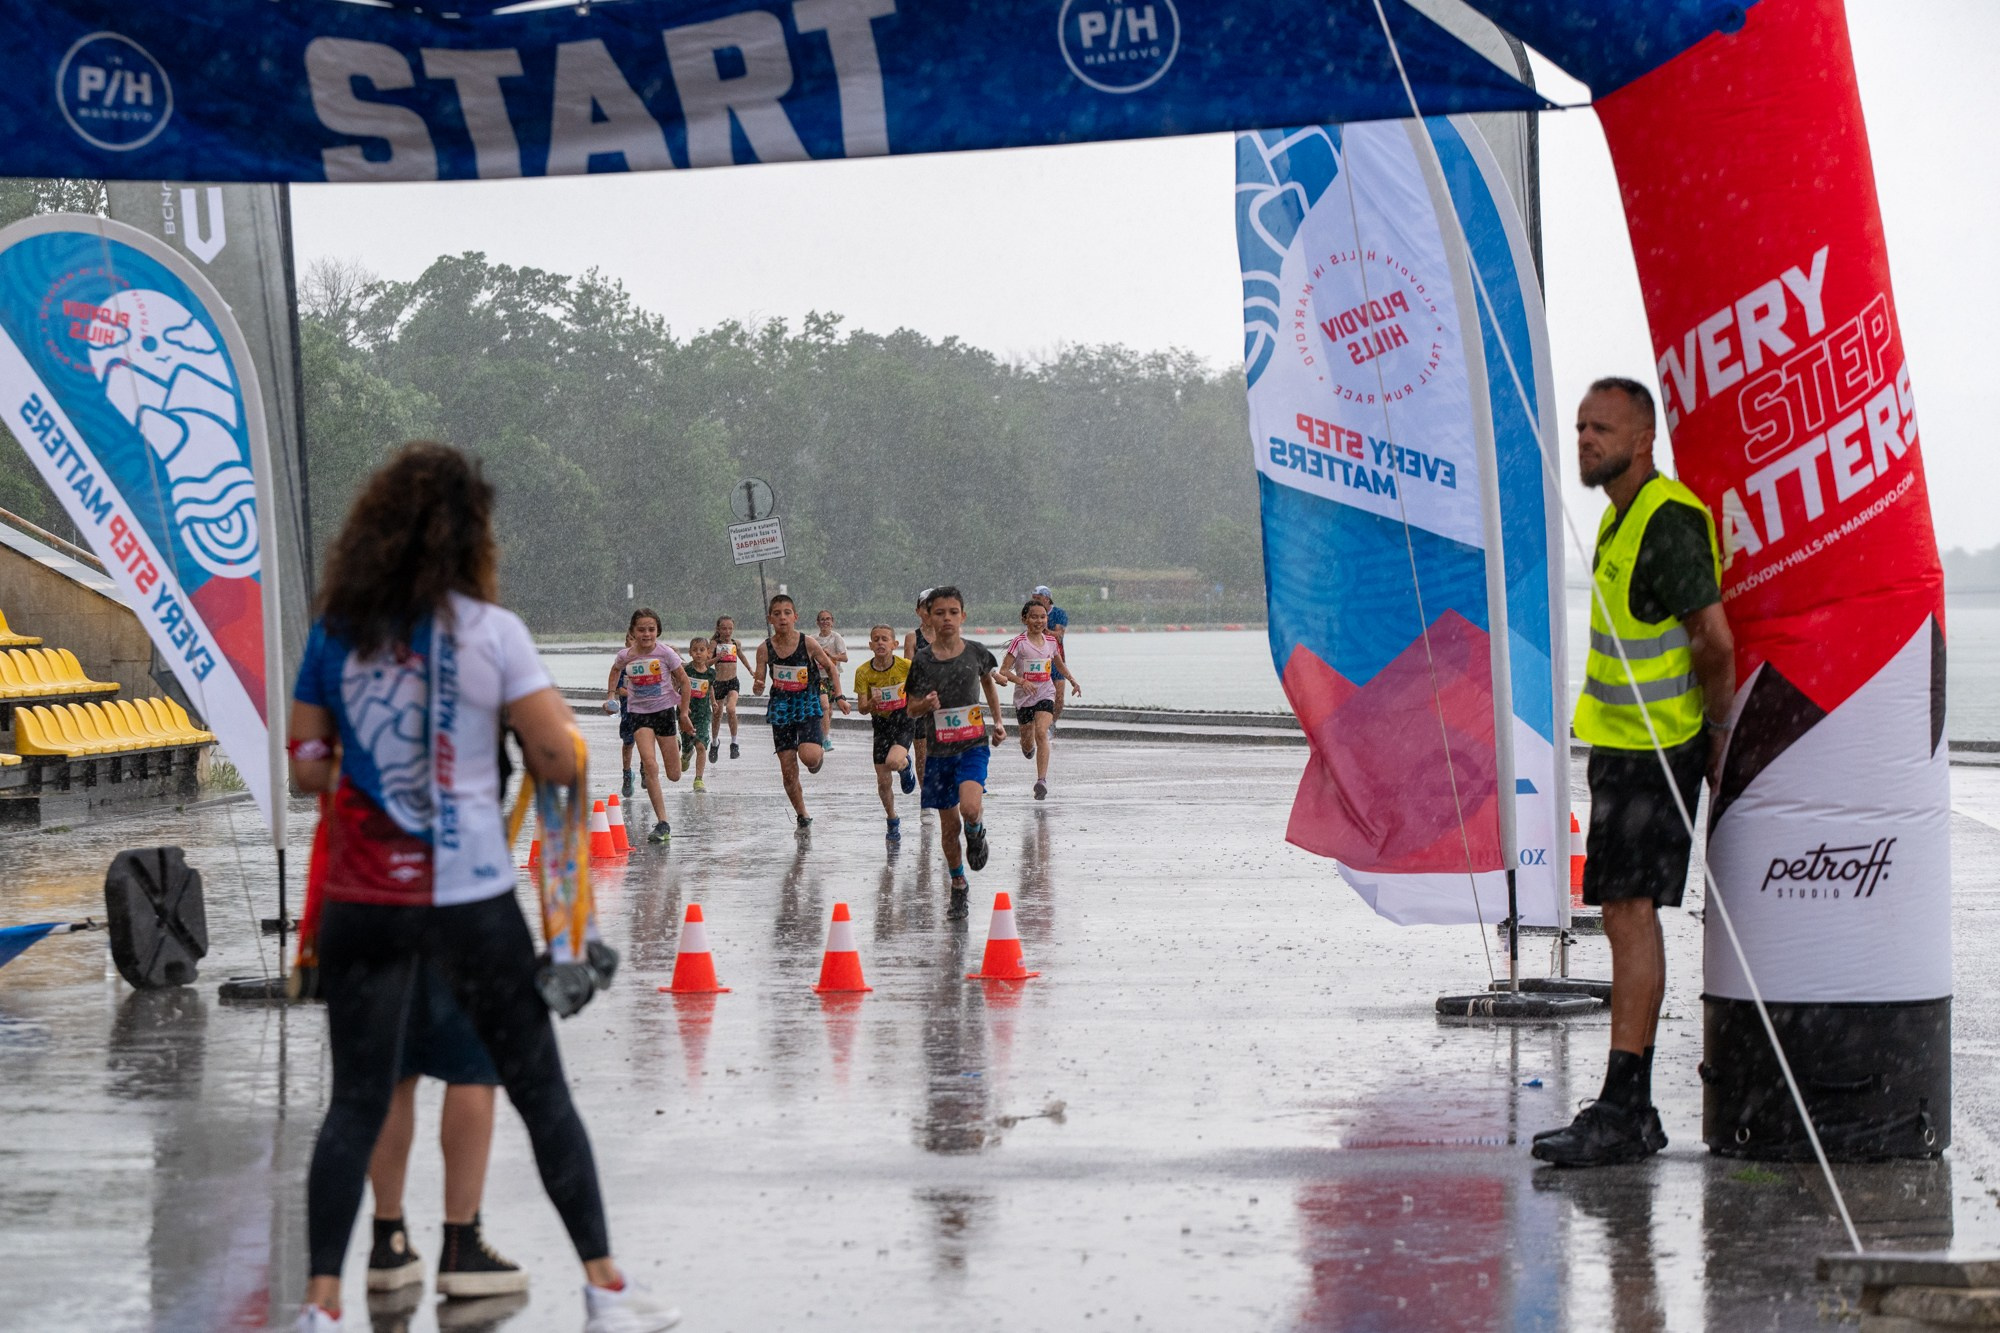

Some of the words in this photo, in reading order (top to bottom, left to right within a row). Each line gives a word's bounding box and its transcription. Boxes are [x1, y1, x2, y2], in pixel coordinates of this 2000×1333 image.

[1078, 5, 1158, 49] P/H
[1084, 46, 1160, 65] MARKOVO
[78, 65, 153, 107] P/H
[304, 0, 896, 182] START
[1657, 244, 1829, 433] EVERY
[1738, 292, 1892, 464] STEP
[736, 536, 778, 550] ЗАБРАНЕНИ!
[631, 665, 645, 675] 50
[778, 670, 792, 680] 64
[944, 714, 962, 727] 16
[1760, 837, 1898, 898] petroff.
[1777, 888, 1841, 899] STUDIO
